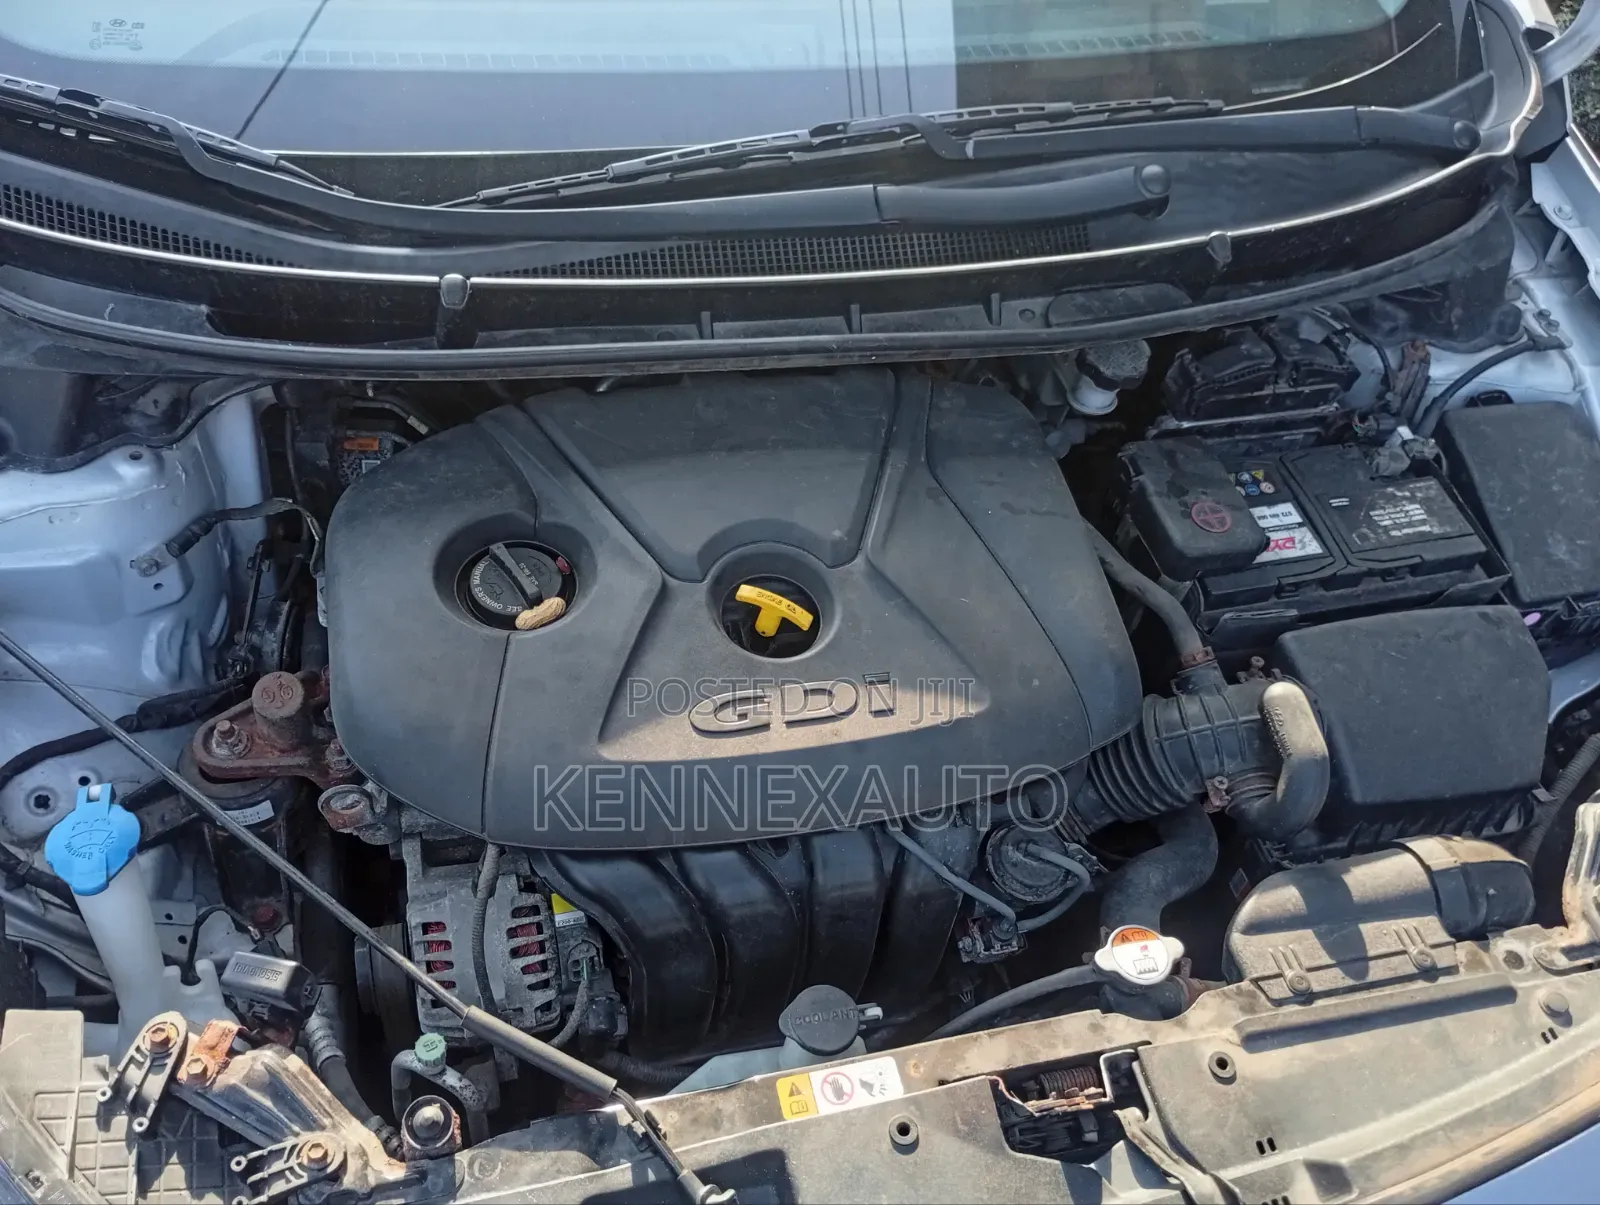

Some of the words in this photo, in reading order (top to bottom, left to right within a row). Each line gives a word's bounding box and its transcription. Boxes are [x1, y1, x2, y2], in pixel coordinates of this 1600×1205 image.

[1266, 536, 1296, 552] DY
[472, 560, 490, 585] MANUAL
[474, 586, 504, 610] OWNER'S
[505, 604, 523, 612] SEE
[63, 840, 94, 860] WASHER
[232, 962, 282, 982] DIAGNOSIS
[794, 1007, 858, 1026] COOLANT
